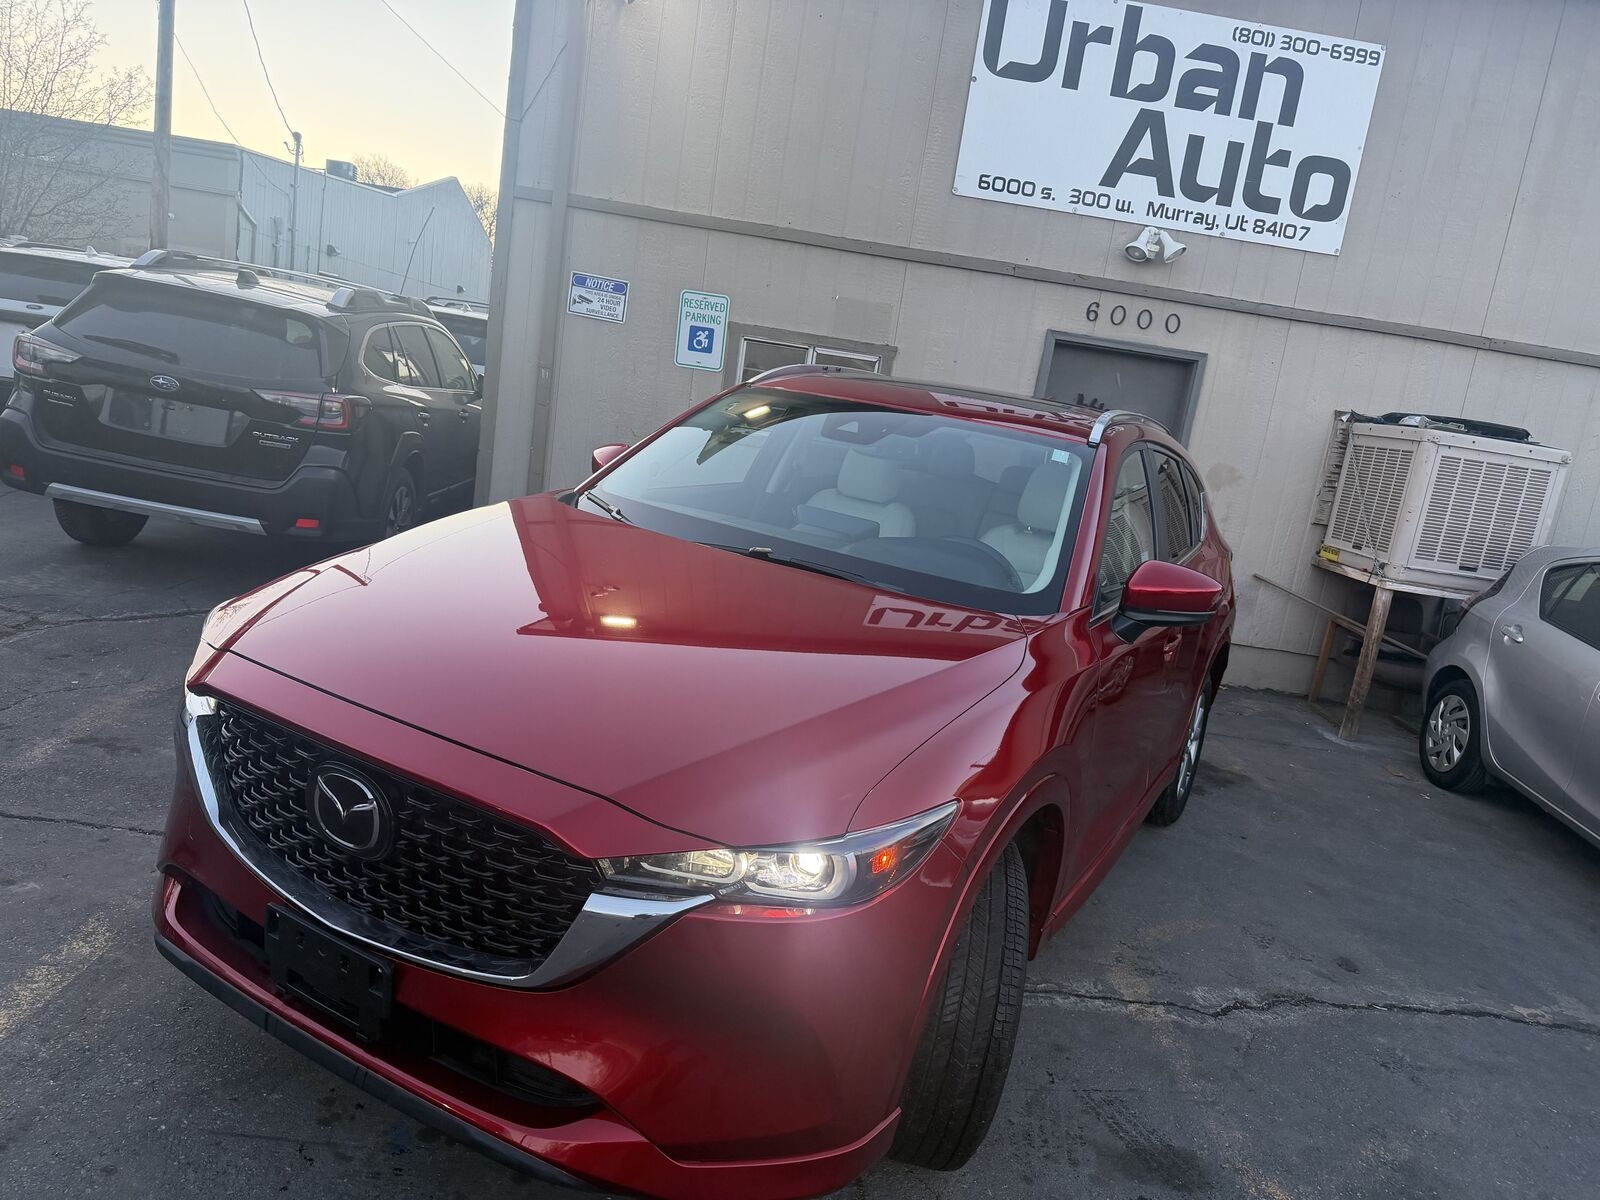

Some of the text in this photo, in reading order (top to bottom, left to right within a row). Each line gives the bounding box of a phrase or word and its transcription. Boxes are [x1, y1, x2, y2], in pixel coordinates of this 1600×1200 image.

[1231, 26, 1381, 67] (801) 300-6999
[982, 0, 1304, 127] Urban
[1098, 108, 1352, 222] Auto
[977, 174, 1036, 198] 6000
[1069, 188, 1111, 210] 300
[1146, 201, 1219, 231] Murray,
[1225, 213, 1249, 233] Ut
[1252, 218, 1311, 242] 84107
[585, 278, 615, 291] NOTICE
[600, 304, 617, 313] VIDEO
[605, 298, 621, 306] HOUR
[683, 298, 726, 313] RESERVED
[685, 311, 722, 325] PARKING
[1086, 302, 1181, 334] 6000
